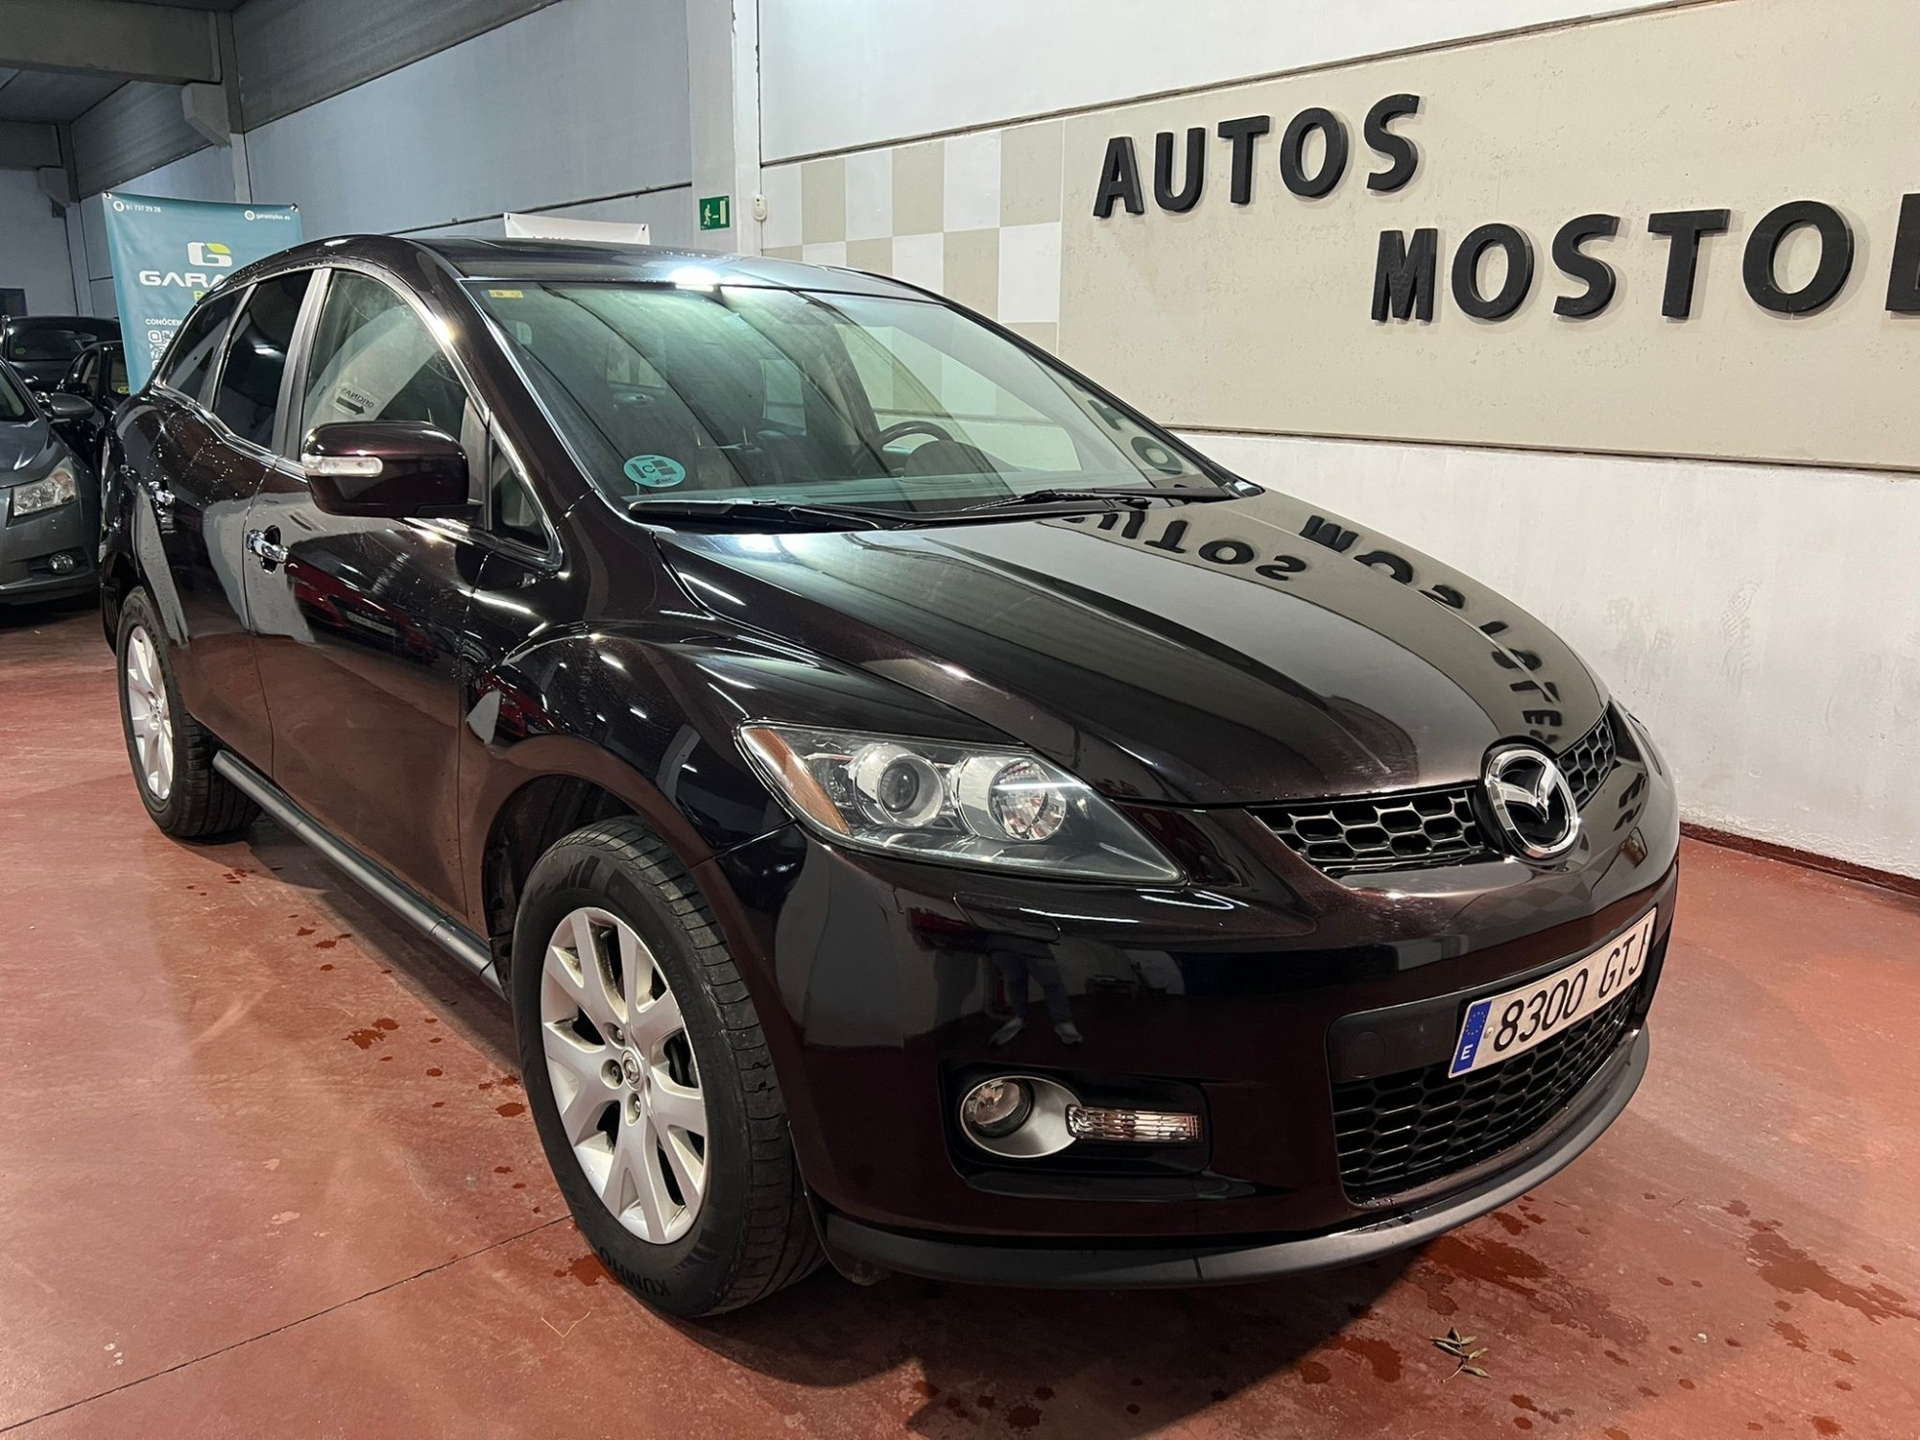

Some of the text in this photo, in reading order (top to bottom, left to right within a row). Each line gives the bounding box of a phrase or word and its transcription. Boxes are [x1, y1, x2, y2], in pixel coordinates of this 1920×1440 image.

[1093, 93, 1423, 219] AUTOS
[1493, 922, 1650, 1053] 8300 GTJ
[1460, 1043, 1474, 1061] E
